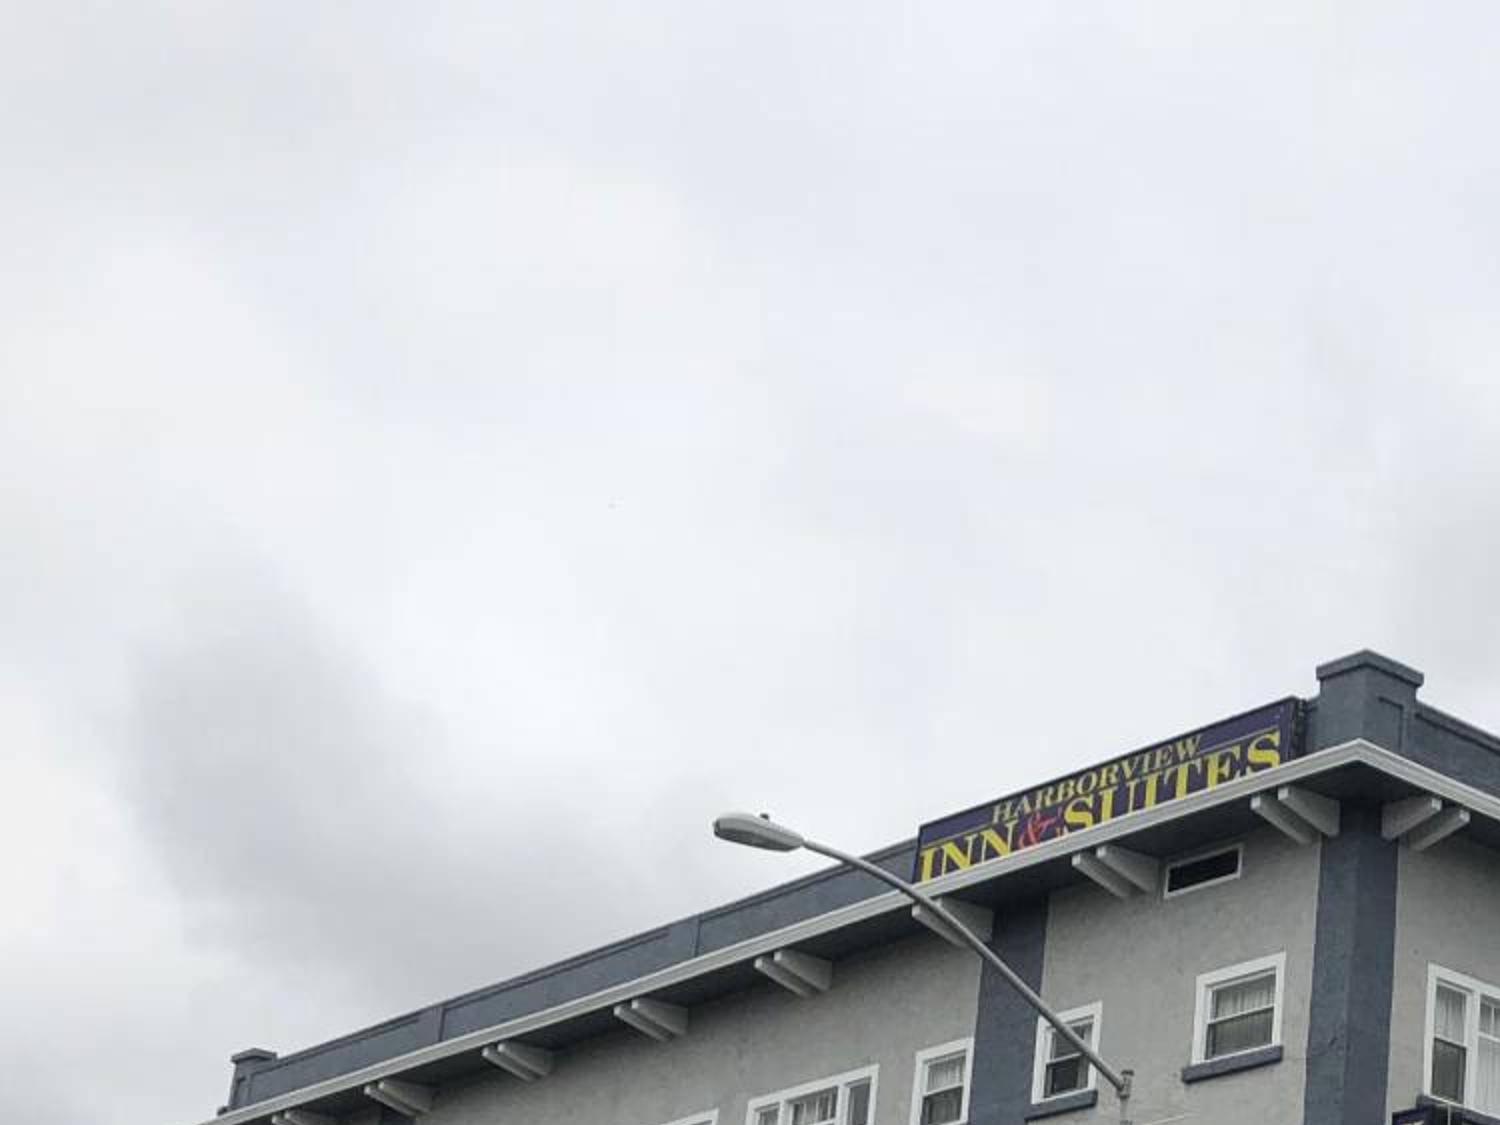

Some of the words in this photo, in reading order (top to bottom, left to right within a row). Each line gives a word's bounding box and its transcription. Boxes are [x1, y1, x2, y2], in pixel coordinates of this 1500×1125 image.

[920, 820, 1019, 882] INN
[1064, 730, 1282, 830] SUITES
[992, 734, 1202, 825] HARBORVIEW
